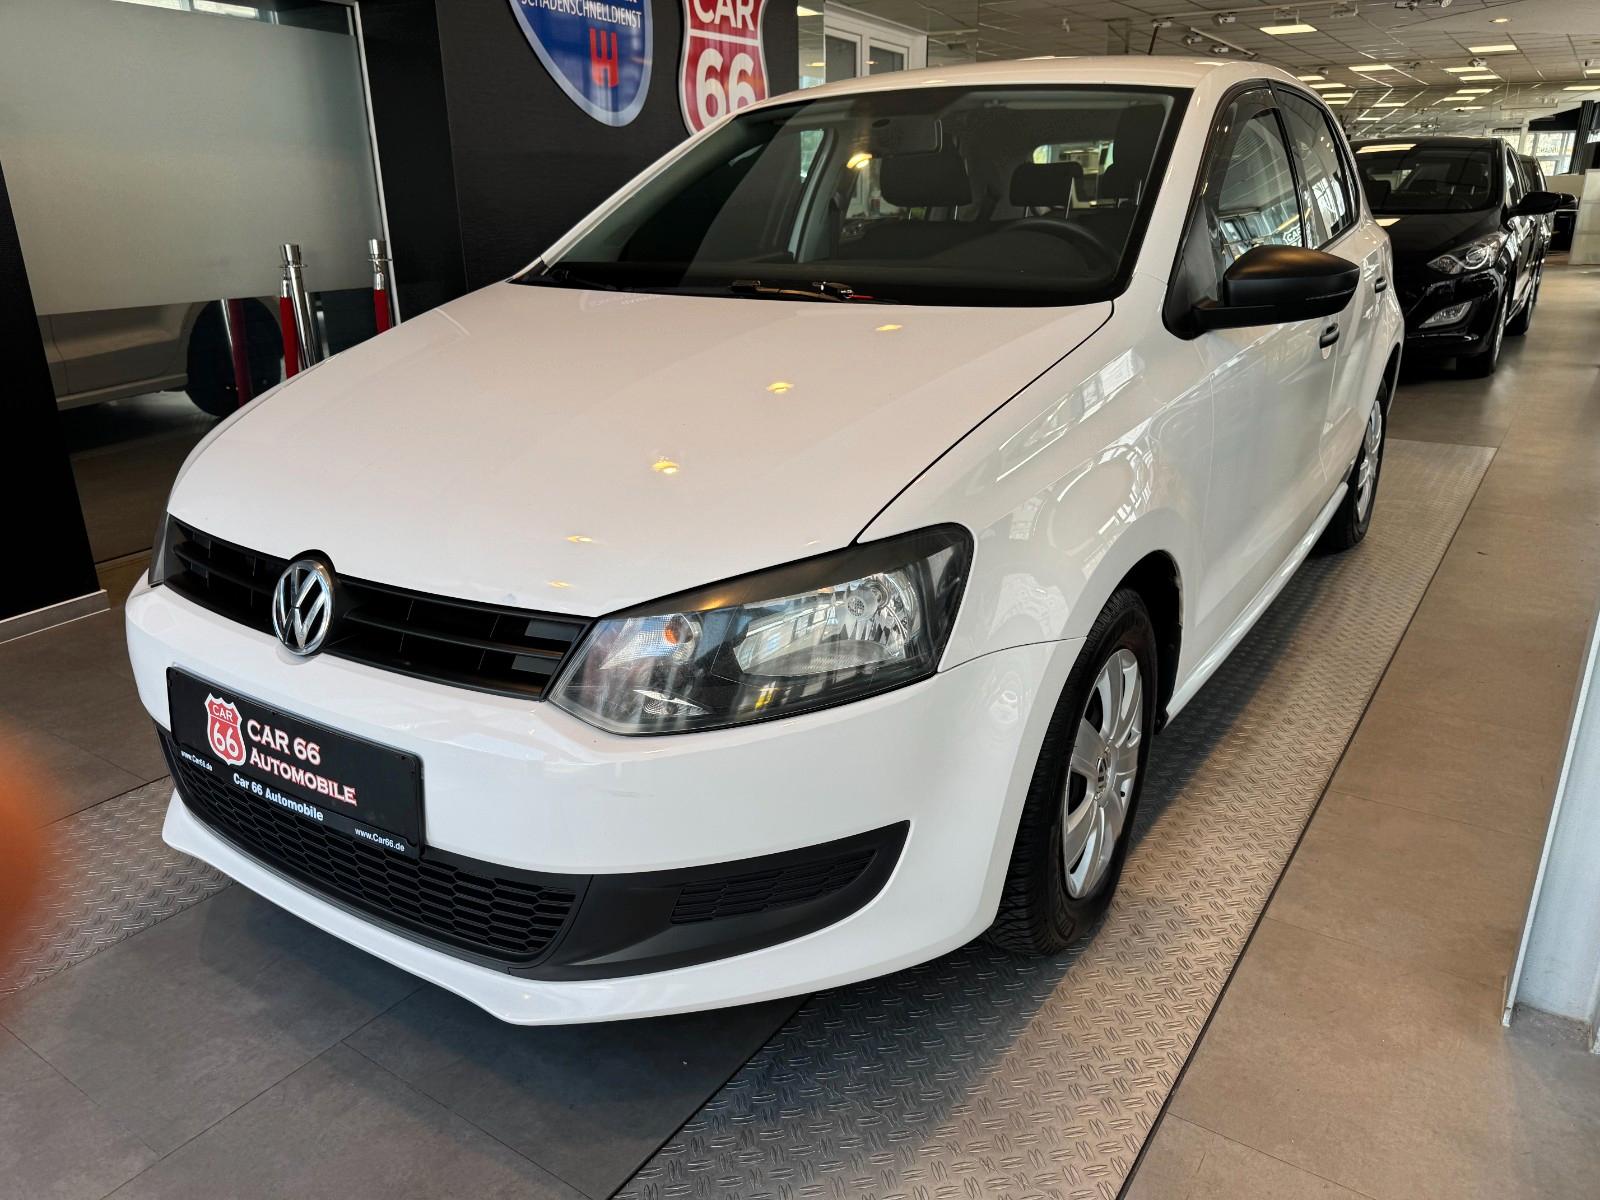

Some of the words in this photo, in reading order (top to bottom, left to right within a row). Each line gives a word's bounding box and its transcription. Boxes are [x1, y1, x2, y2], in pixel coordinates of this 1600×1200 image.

[694, 0, 755, 31] CAR
[696, 48, 756, 126] 66
[212, 704, 234, 722] CAR
[213, 722, 239, 758] 66
[247, 719, 291, 755] CAR
[293, 737, 321, 765] 66
[233, 772, 250, 789] Car
[251, 781, 263, 796] 66
[265, 787, 324, 822] Automobile
[249, 747, 357, 807] AUTOMOBILE
[354, 827, 405, 852] www.Car66.de
